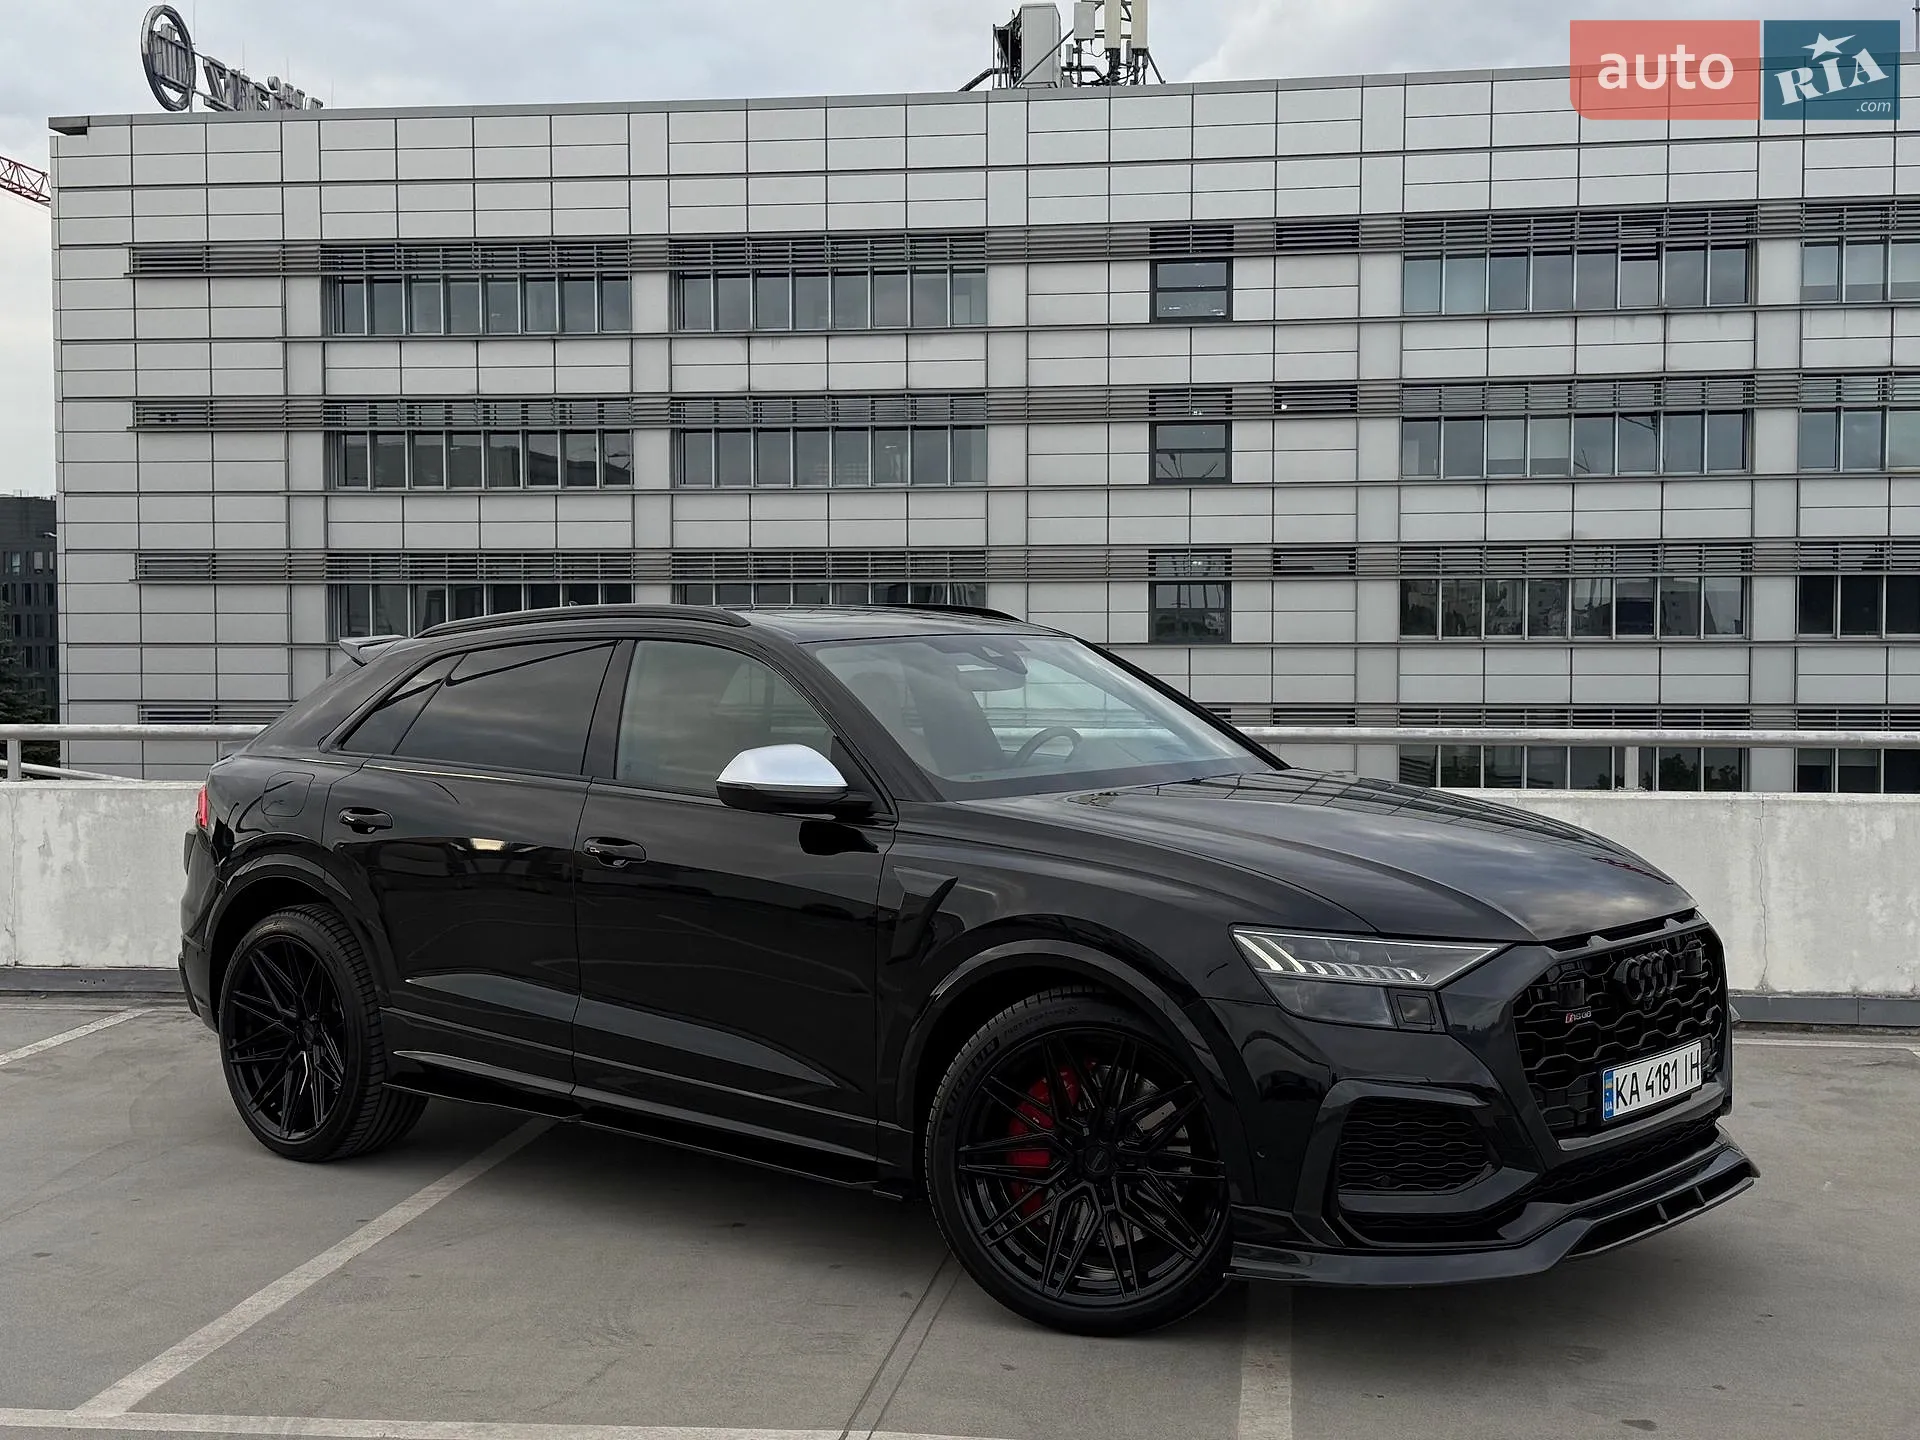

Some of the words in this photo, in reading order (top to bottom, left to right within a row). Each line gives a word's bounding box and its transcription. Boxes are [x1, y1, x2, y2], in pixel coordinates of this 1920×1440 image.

[1615, 1072, 1640, 1109] KA
[1645, 1058, 1678, 1098] 4181
[1684, 1049, 1700, 1085] IH
